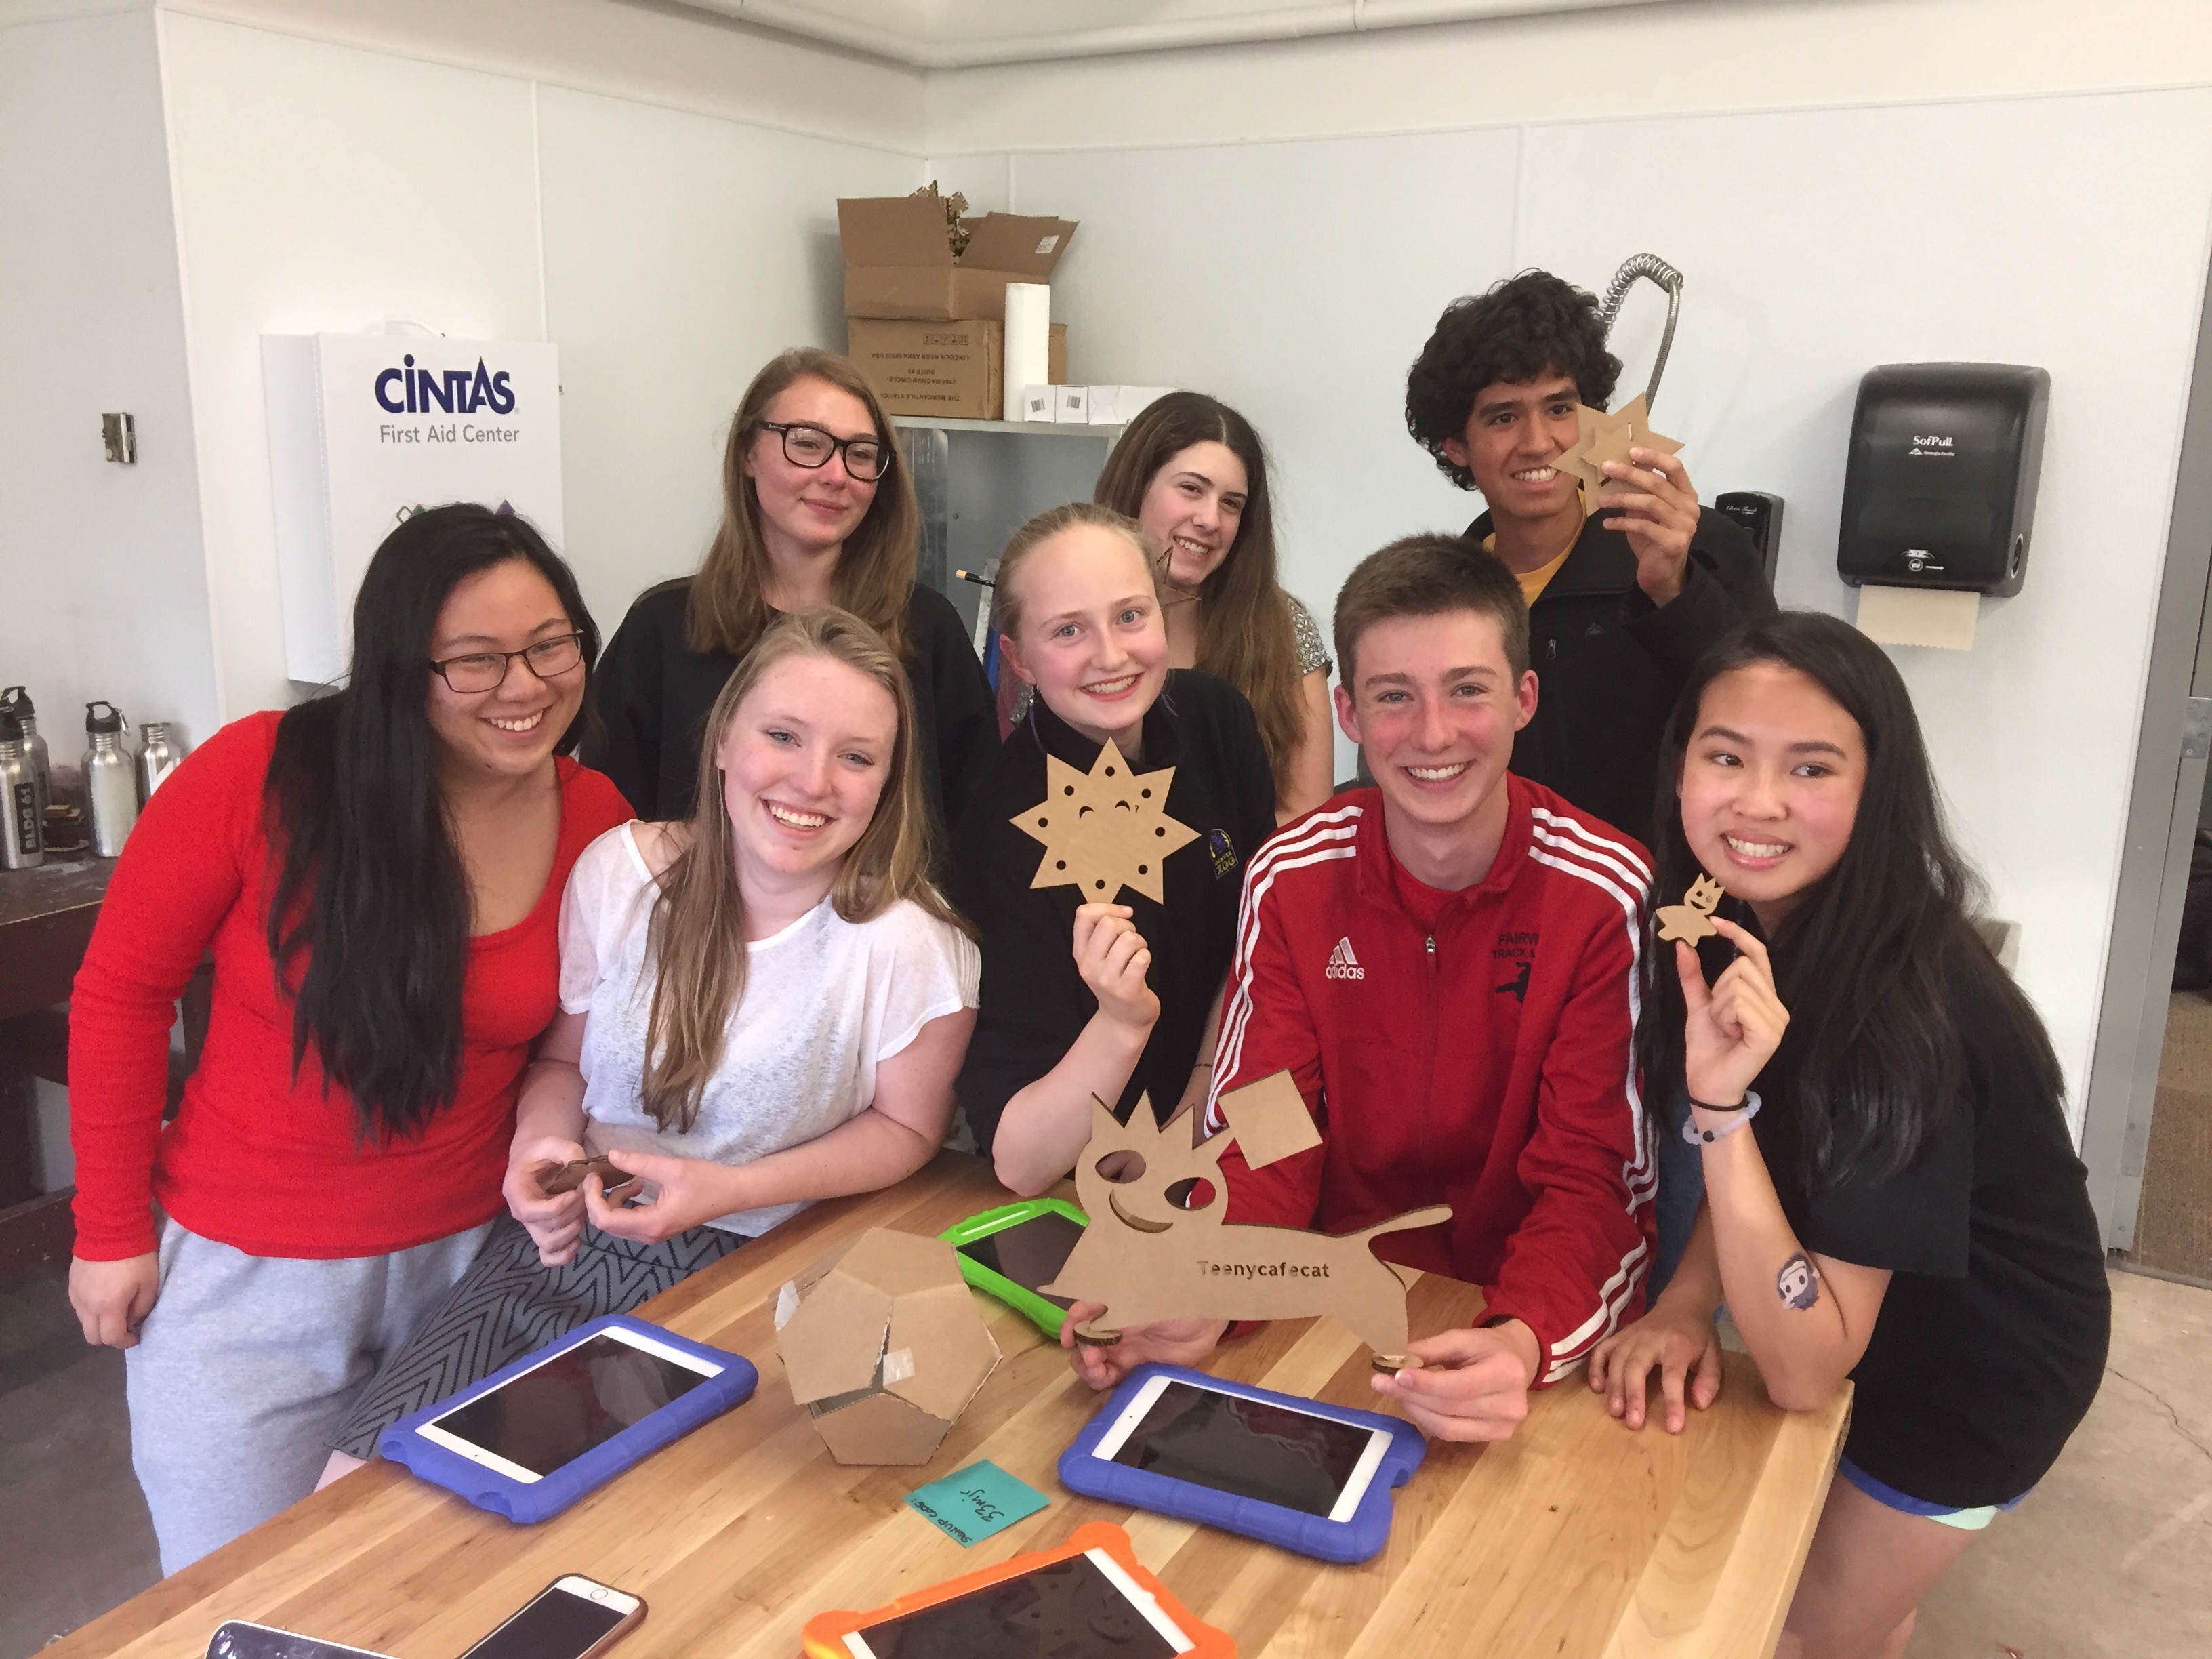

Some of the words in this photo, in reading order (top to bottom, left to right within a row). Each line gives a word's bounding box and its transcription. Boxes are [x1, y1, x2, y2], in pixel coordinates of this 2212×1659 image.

[380, 424, 420, 443] First
[427, 424, 456, 443] Aid
[462, 424, 520, 443] Center
[1912, 435, 1954, 447] SofPull
[1217, 856, 1235, 876] ZOO
[1492, 948, 1525, 958] TRACK
[1325, 963, 1365, 981] adidas
[1197, 1260, 1330, 1281] Teenycafecat
